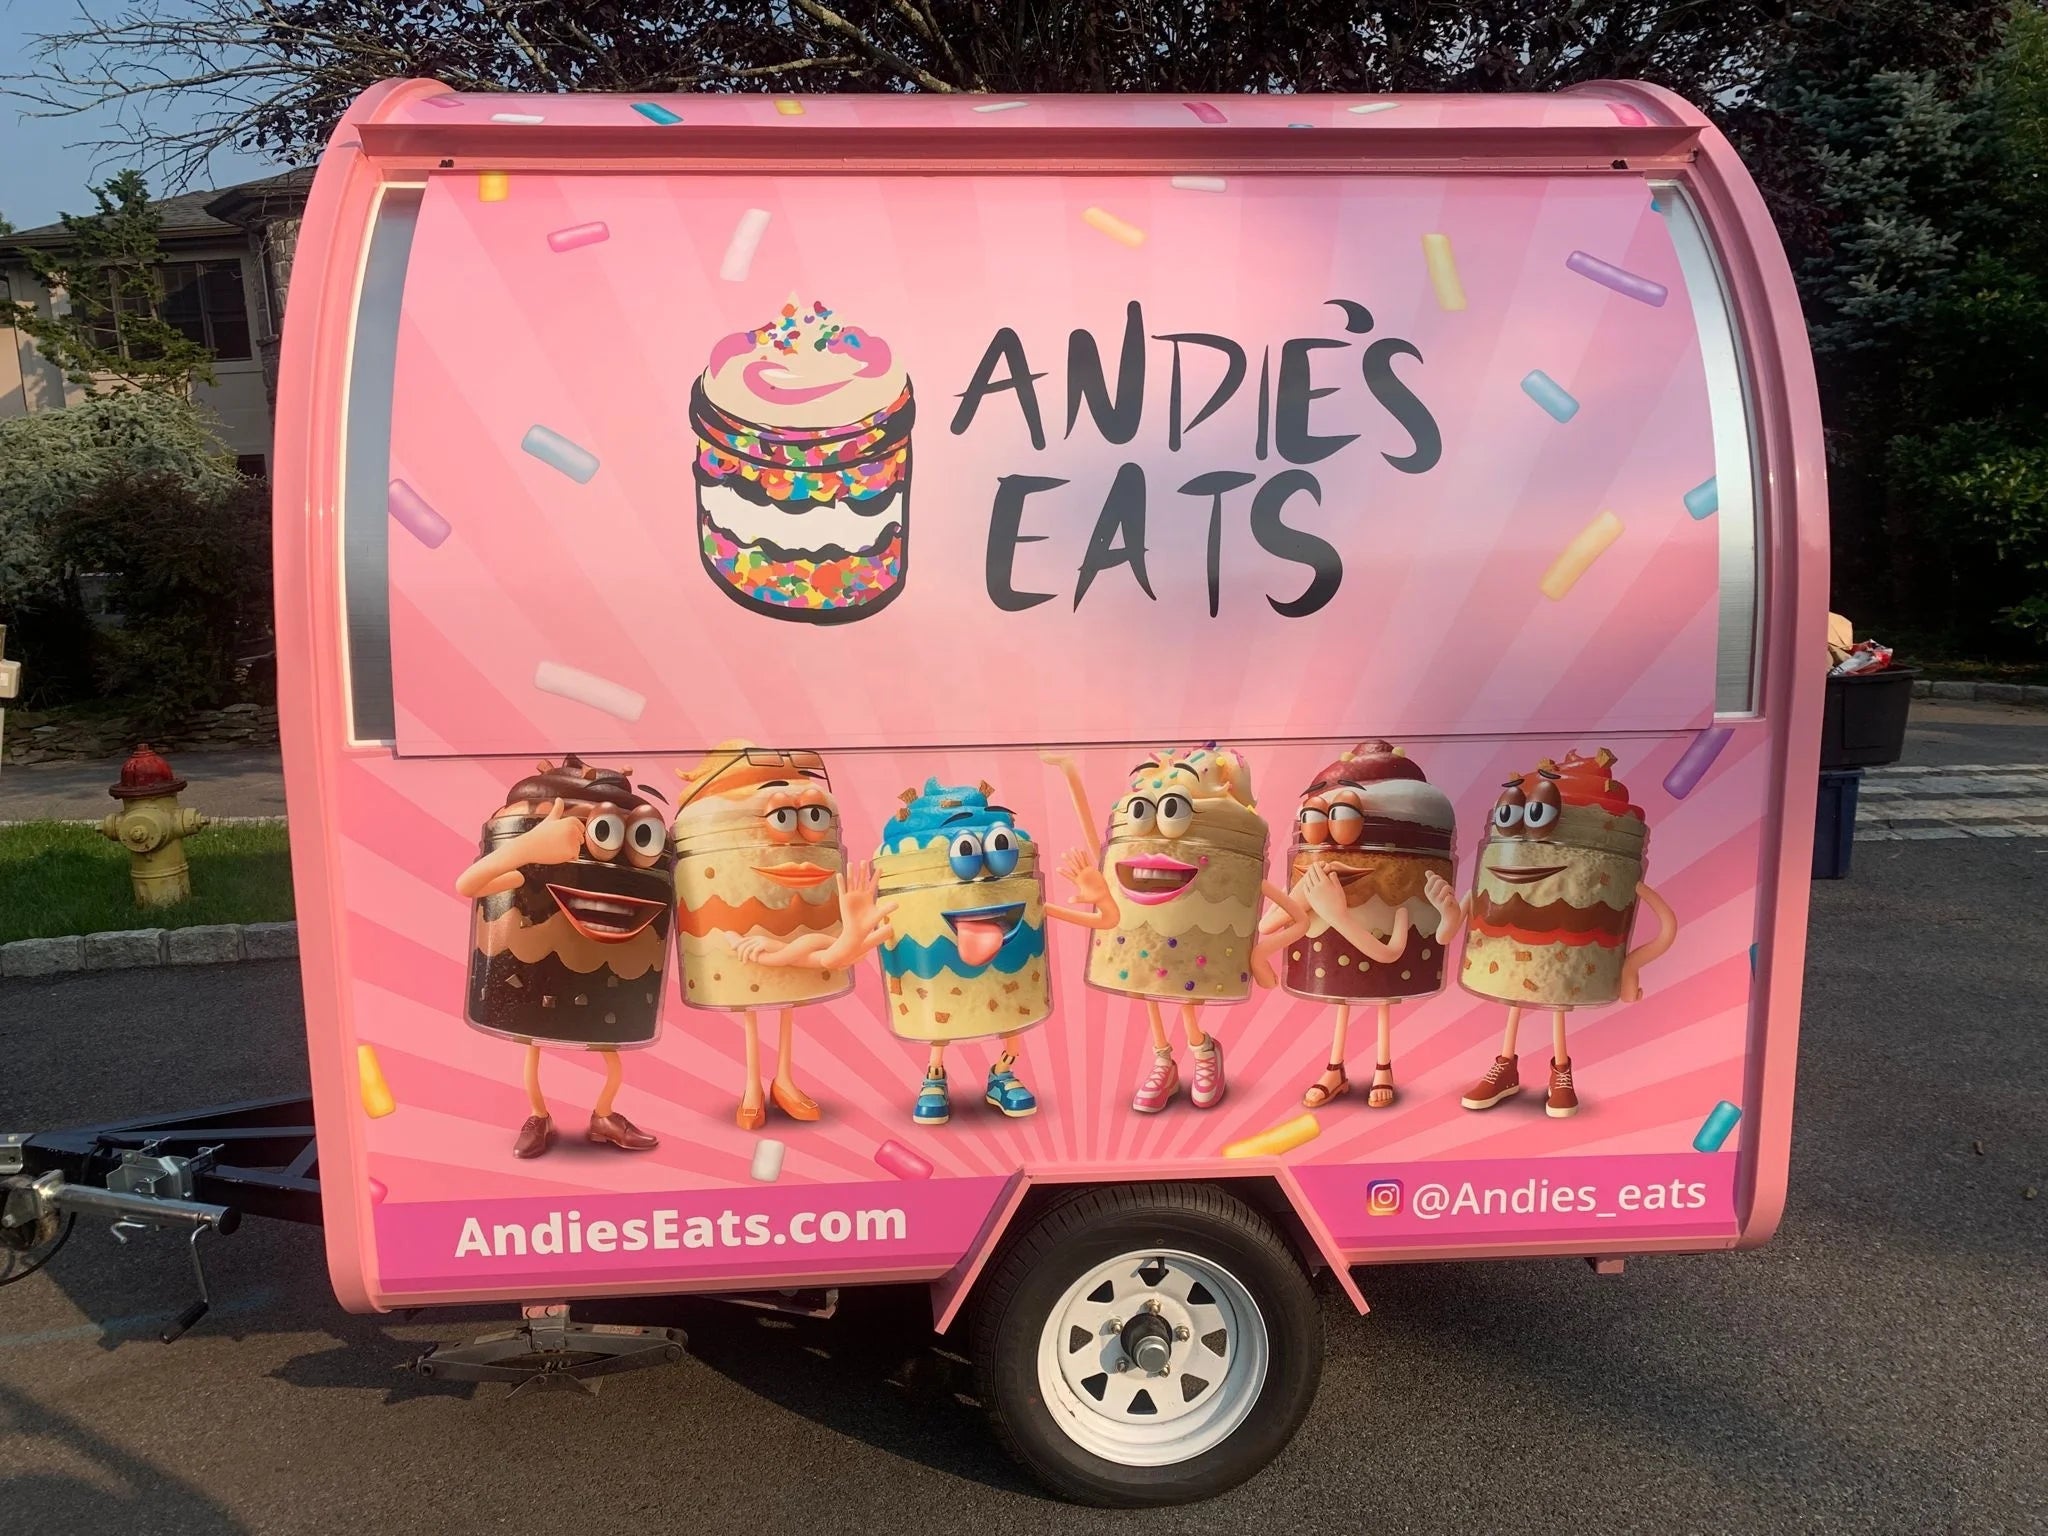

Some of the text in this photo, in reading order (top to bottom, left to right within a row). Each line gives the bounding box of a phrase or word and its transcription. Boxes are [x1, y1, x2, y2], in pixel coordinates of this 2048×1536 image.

[950, 300, 1442, 474] ANDIE'S
[985, 462, 1343, 618] EATS
[454, 1207, 907, 1257] AndiesEats.com
[1412, 1178, 1707, 1219] @Andies_eats
